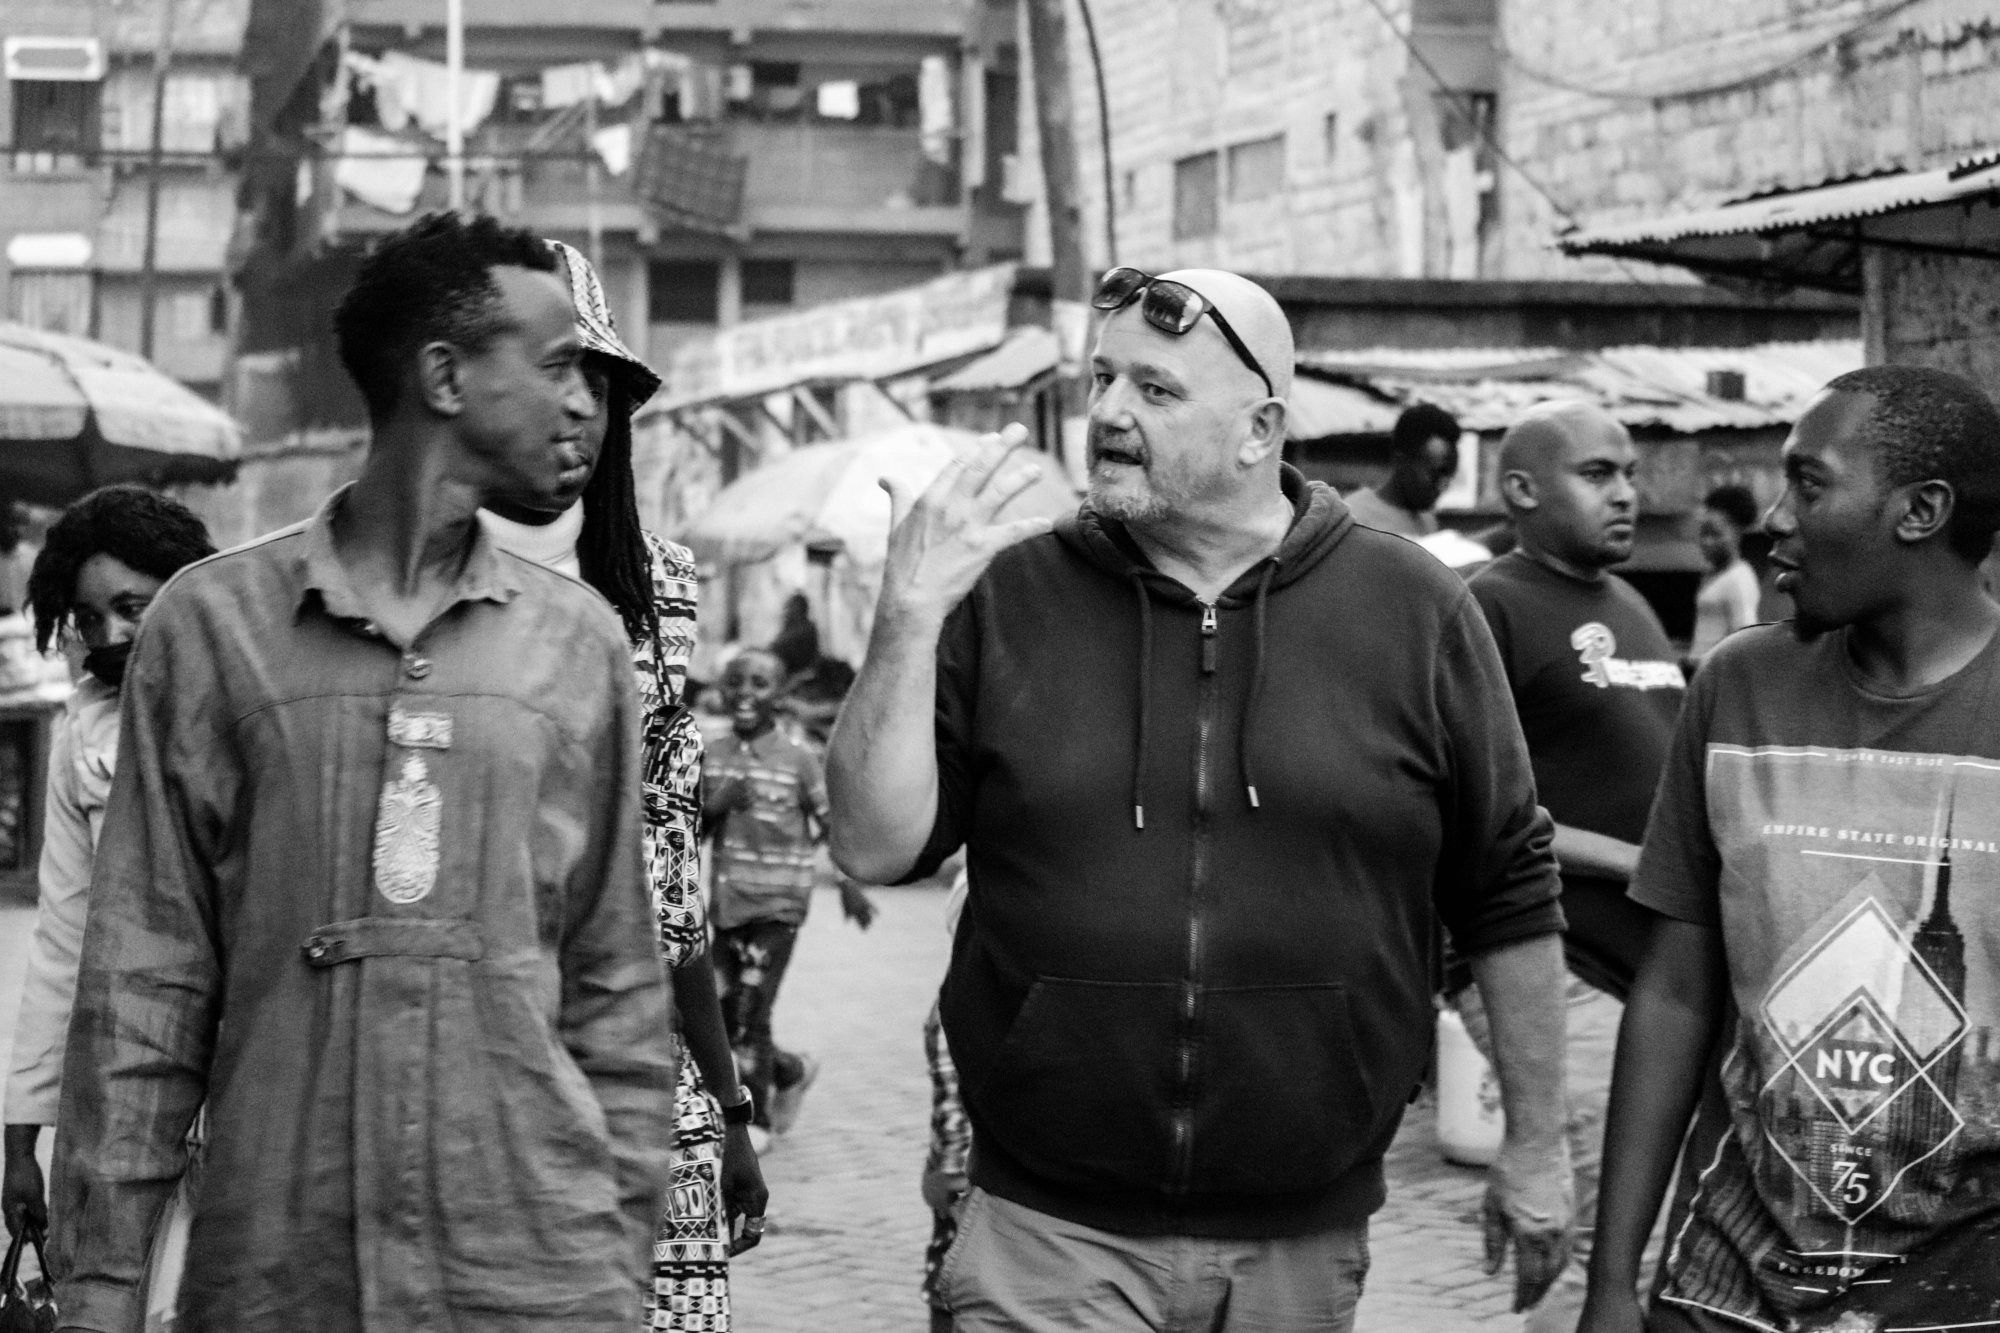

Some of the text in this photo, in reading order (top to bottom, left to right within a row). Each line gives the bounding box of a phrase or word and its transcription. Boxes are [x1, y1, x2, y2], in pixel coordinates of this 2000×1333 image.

[1762, 824, 1999, 853] EMPIRE STATE ORIGINAL
[1816, 1048, 1896, 1084] NYC
[1830, 1143, 1872, 1157] SINCE
[1831, 1161, 1870, 1204] 75
